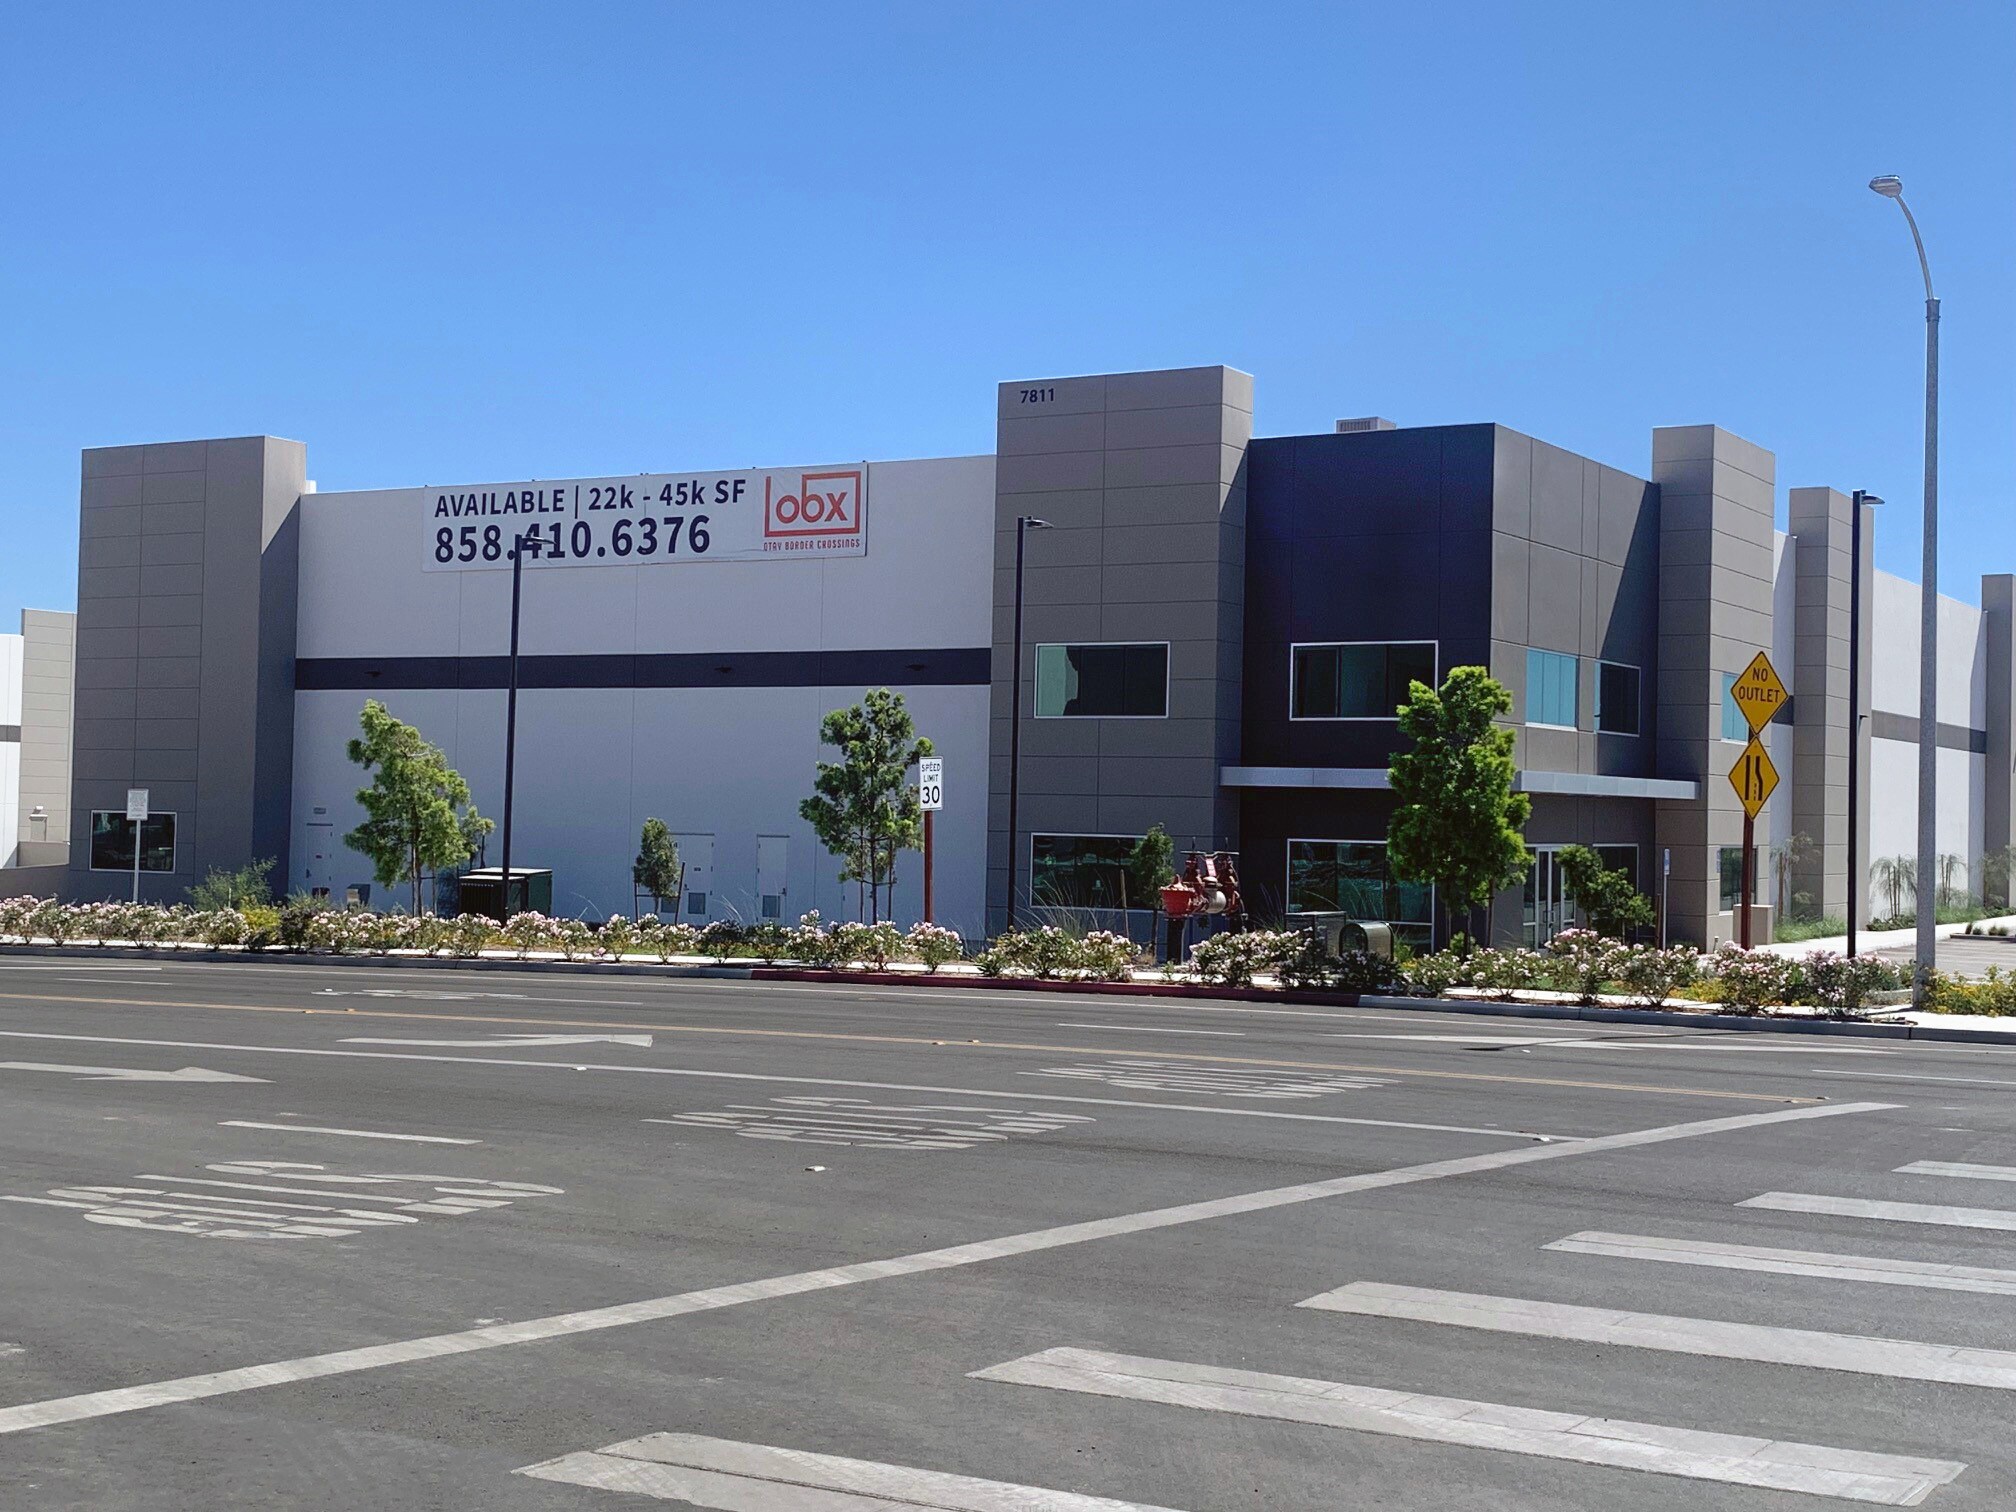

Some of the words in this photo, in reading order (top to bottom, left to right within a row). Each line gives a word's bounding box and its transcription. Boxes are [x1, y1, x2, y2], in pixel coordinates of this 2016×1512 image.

[1020, 388, 1054, 403] 7811
[434, 489, 565, 518] AVAILABLE
[588, 484, 634, 511] 22k
[659, 480, 706, 507] 45k
[714, 479, 746, 504] SF
[775, 473, 849, 525] obx
[435, 515, 710, 563] 858.410.6376
[763, 542, 782, 552] OTAY
[784, 540, 814, 551] BORDER
[817, 538, 860, 550] CROSSINGS
[1752, 667, 1768, 682] NO
[1738, 686, 1780, 702] OUTLET
[921, 763, 941, 772] SPEED
[923, 774, 938, 782] LIMIT
[922, 786, 940, 804] 30
